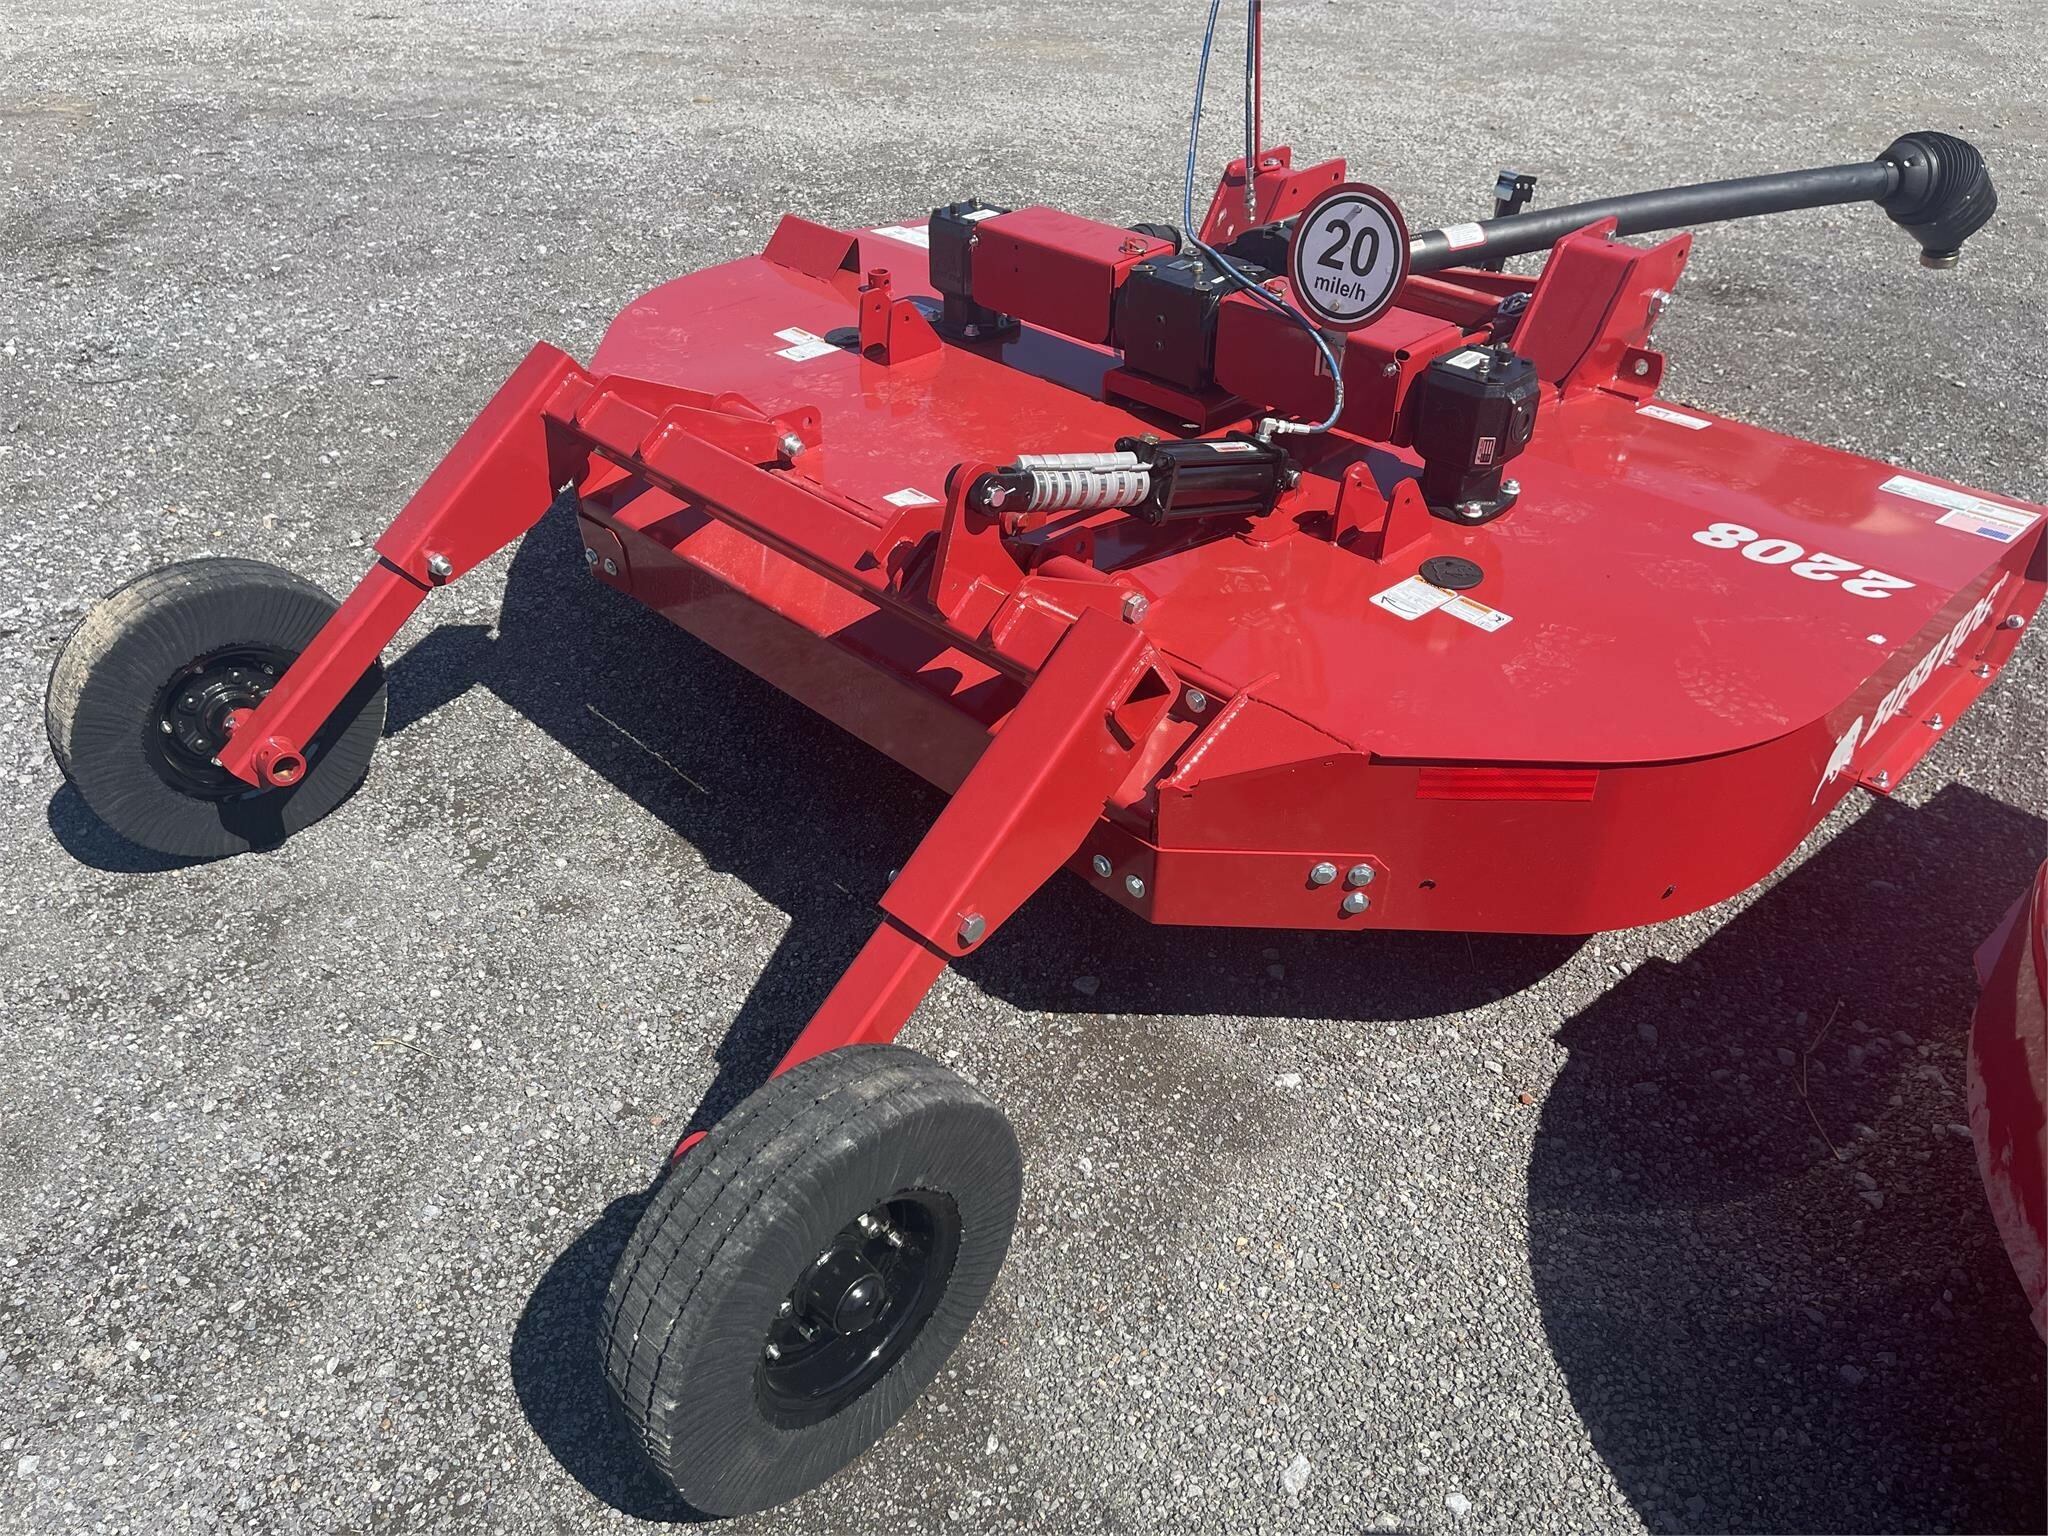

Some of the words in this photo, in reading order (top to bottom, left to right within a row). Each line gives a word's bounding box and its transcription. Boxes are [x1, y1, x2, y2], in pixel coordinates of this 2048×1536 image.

[1317, 219, 1380, 277] 20
[1314, 275, 1366, 302] mile/h
[1692, 522, 1917, 599] 2208
[1860, 633, 1950, 749] BUSH
